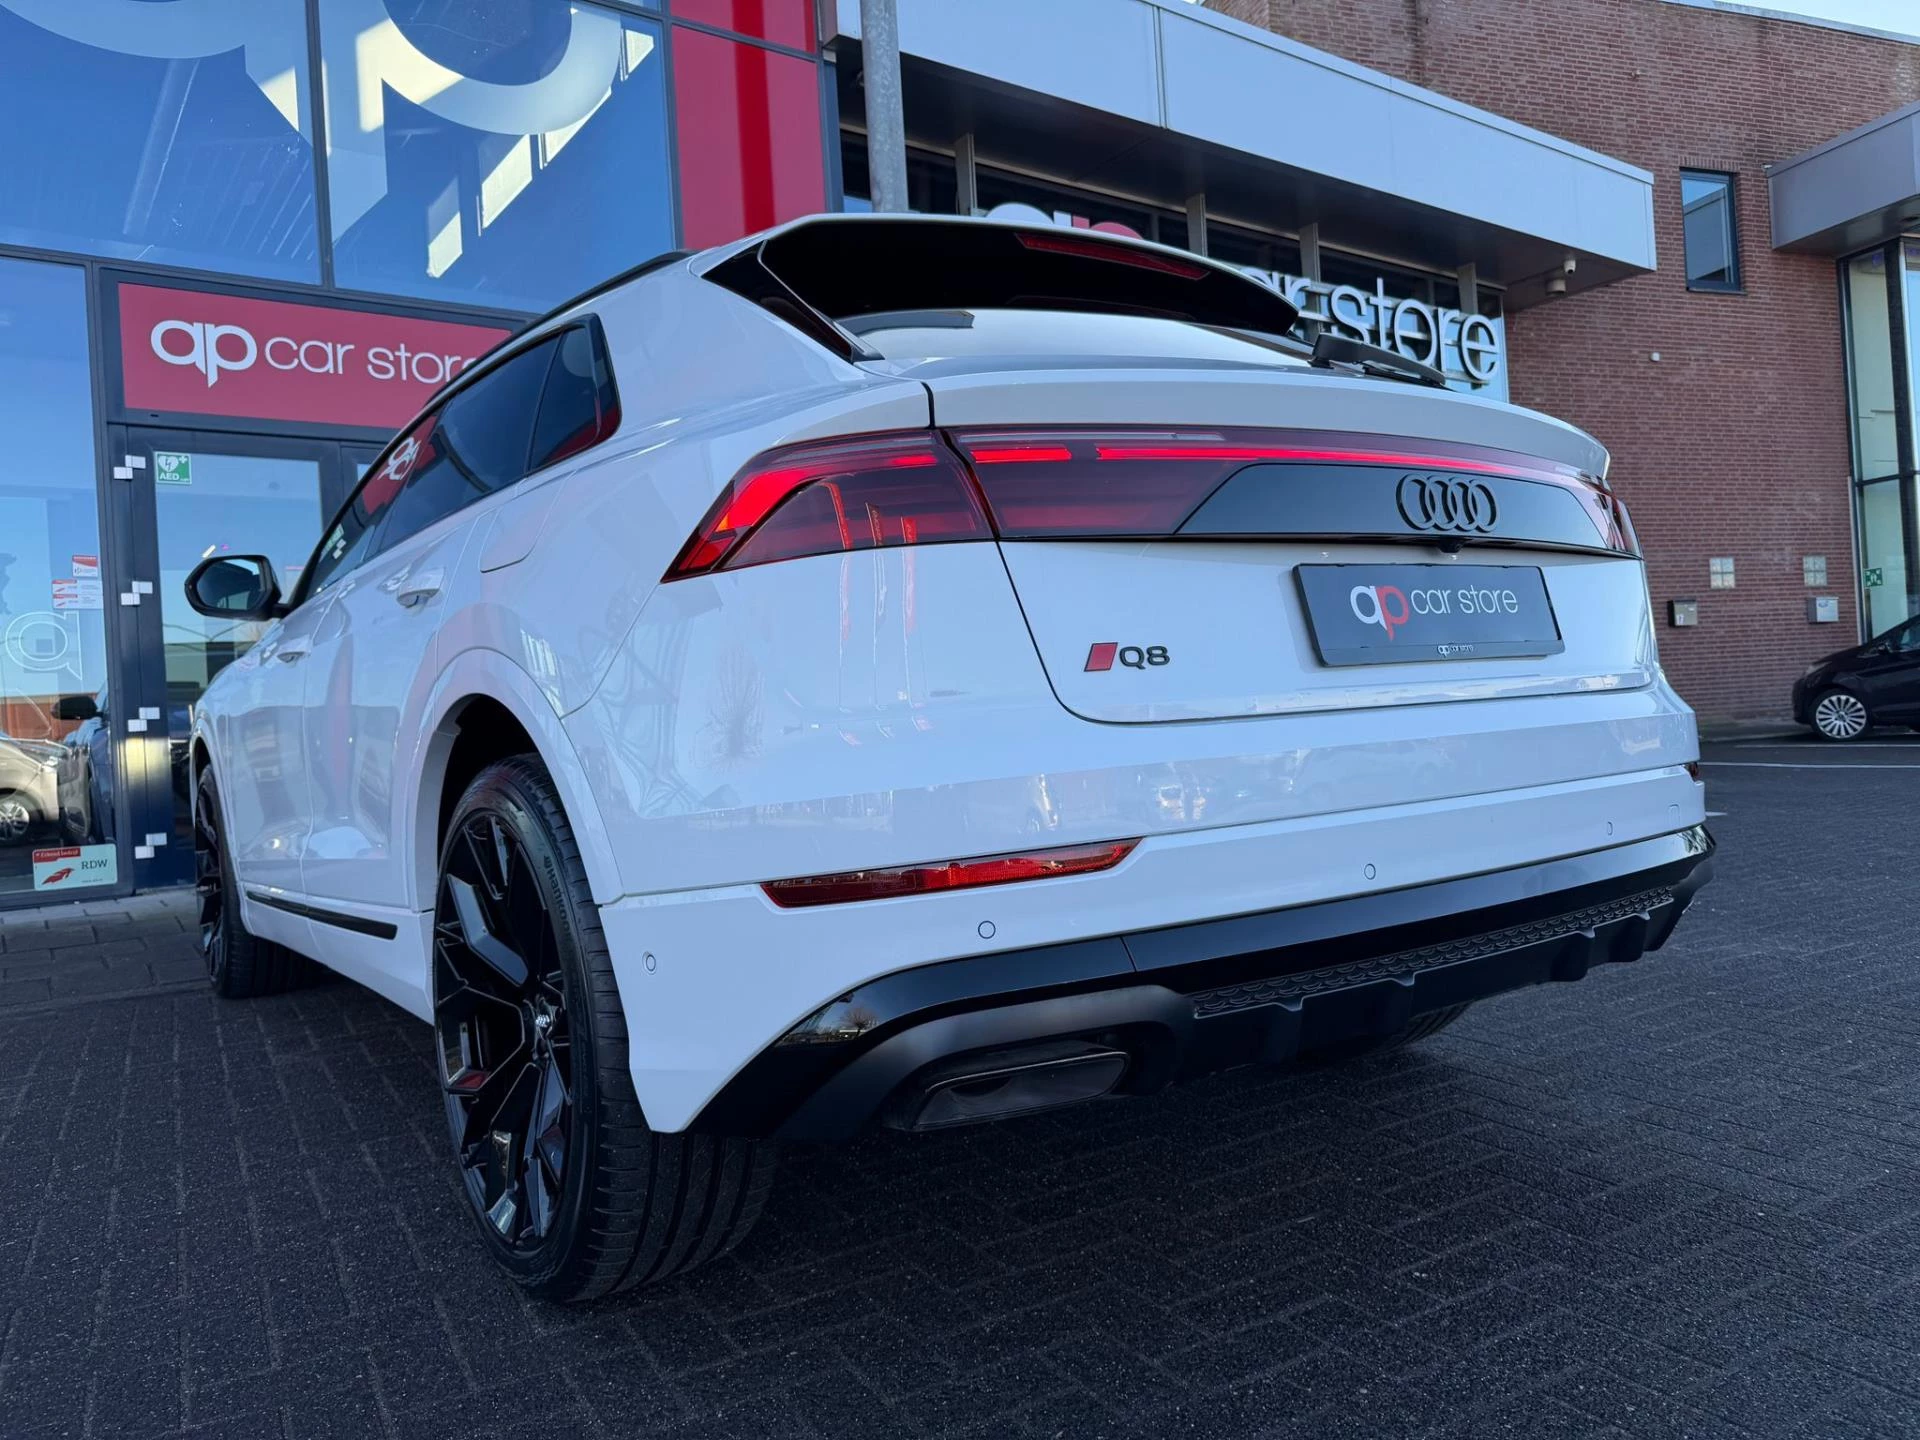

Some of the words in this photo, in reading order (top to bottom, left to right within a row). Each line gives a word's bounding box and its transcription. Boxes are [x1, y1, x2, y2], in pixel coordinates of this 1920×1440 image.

[1330, 277, 1500, 381] store
[150, 319, 257, 388] ap
[265, 336, 355, 375] car
[159, 472, 180, 481] AED
[1350, 585, 1409, 641] ap
[1410, 589, 1452, 614] car
[1457, 584, 1519, 614] store
[1119, 645, 1171, 670] Q8
[81, 859, 108, 870] RDW
